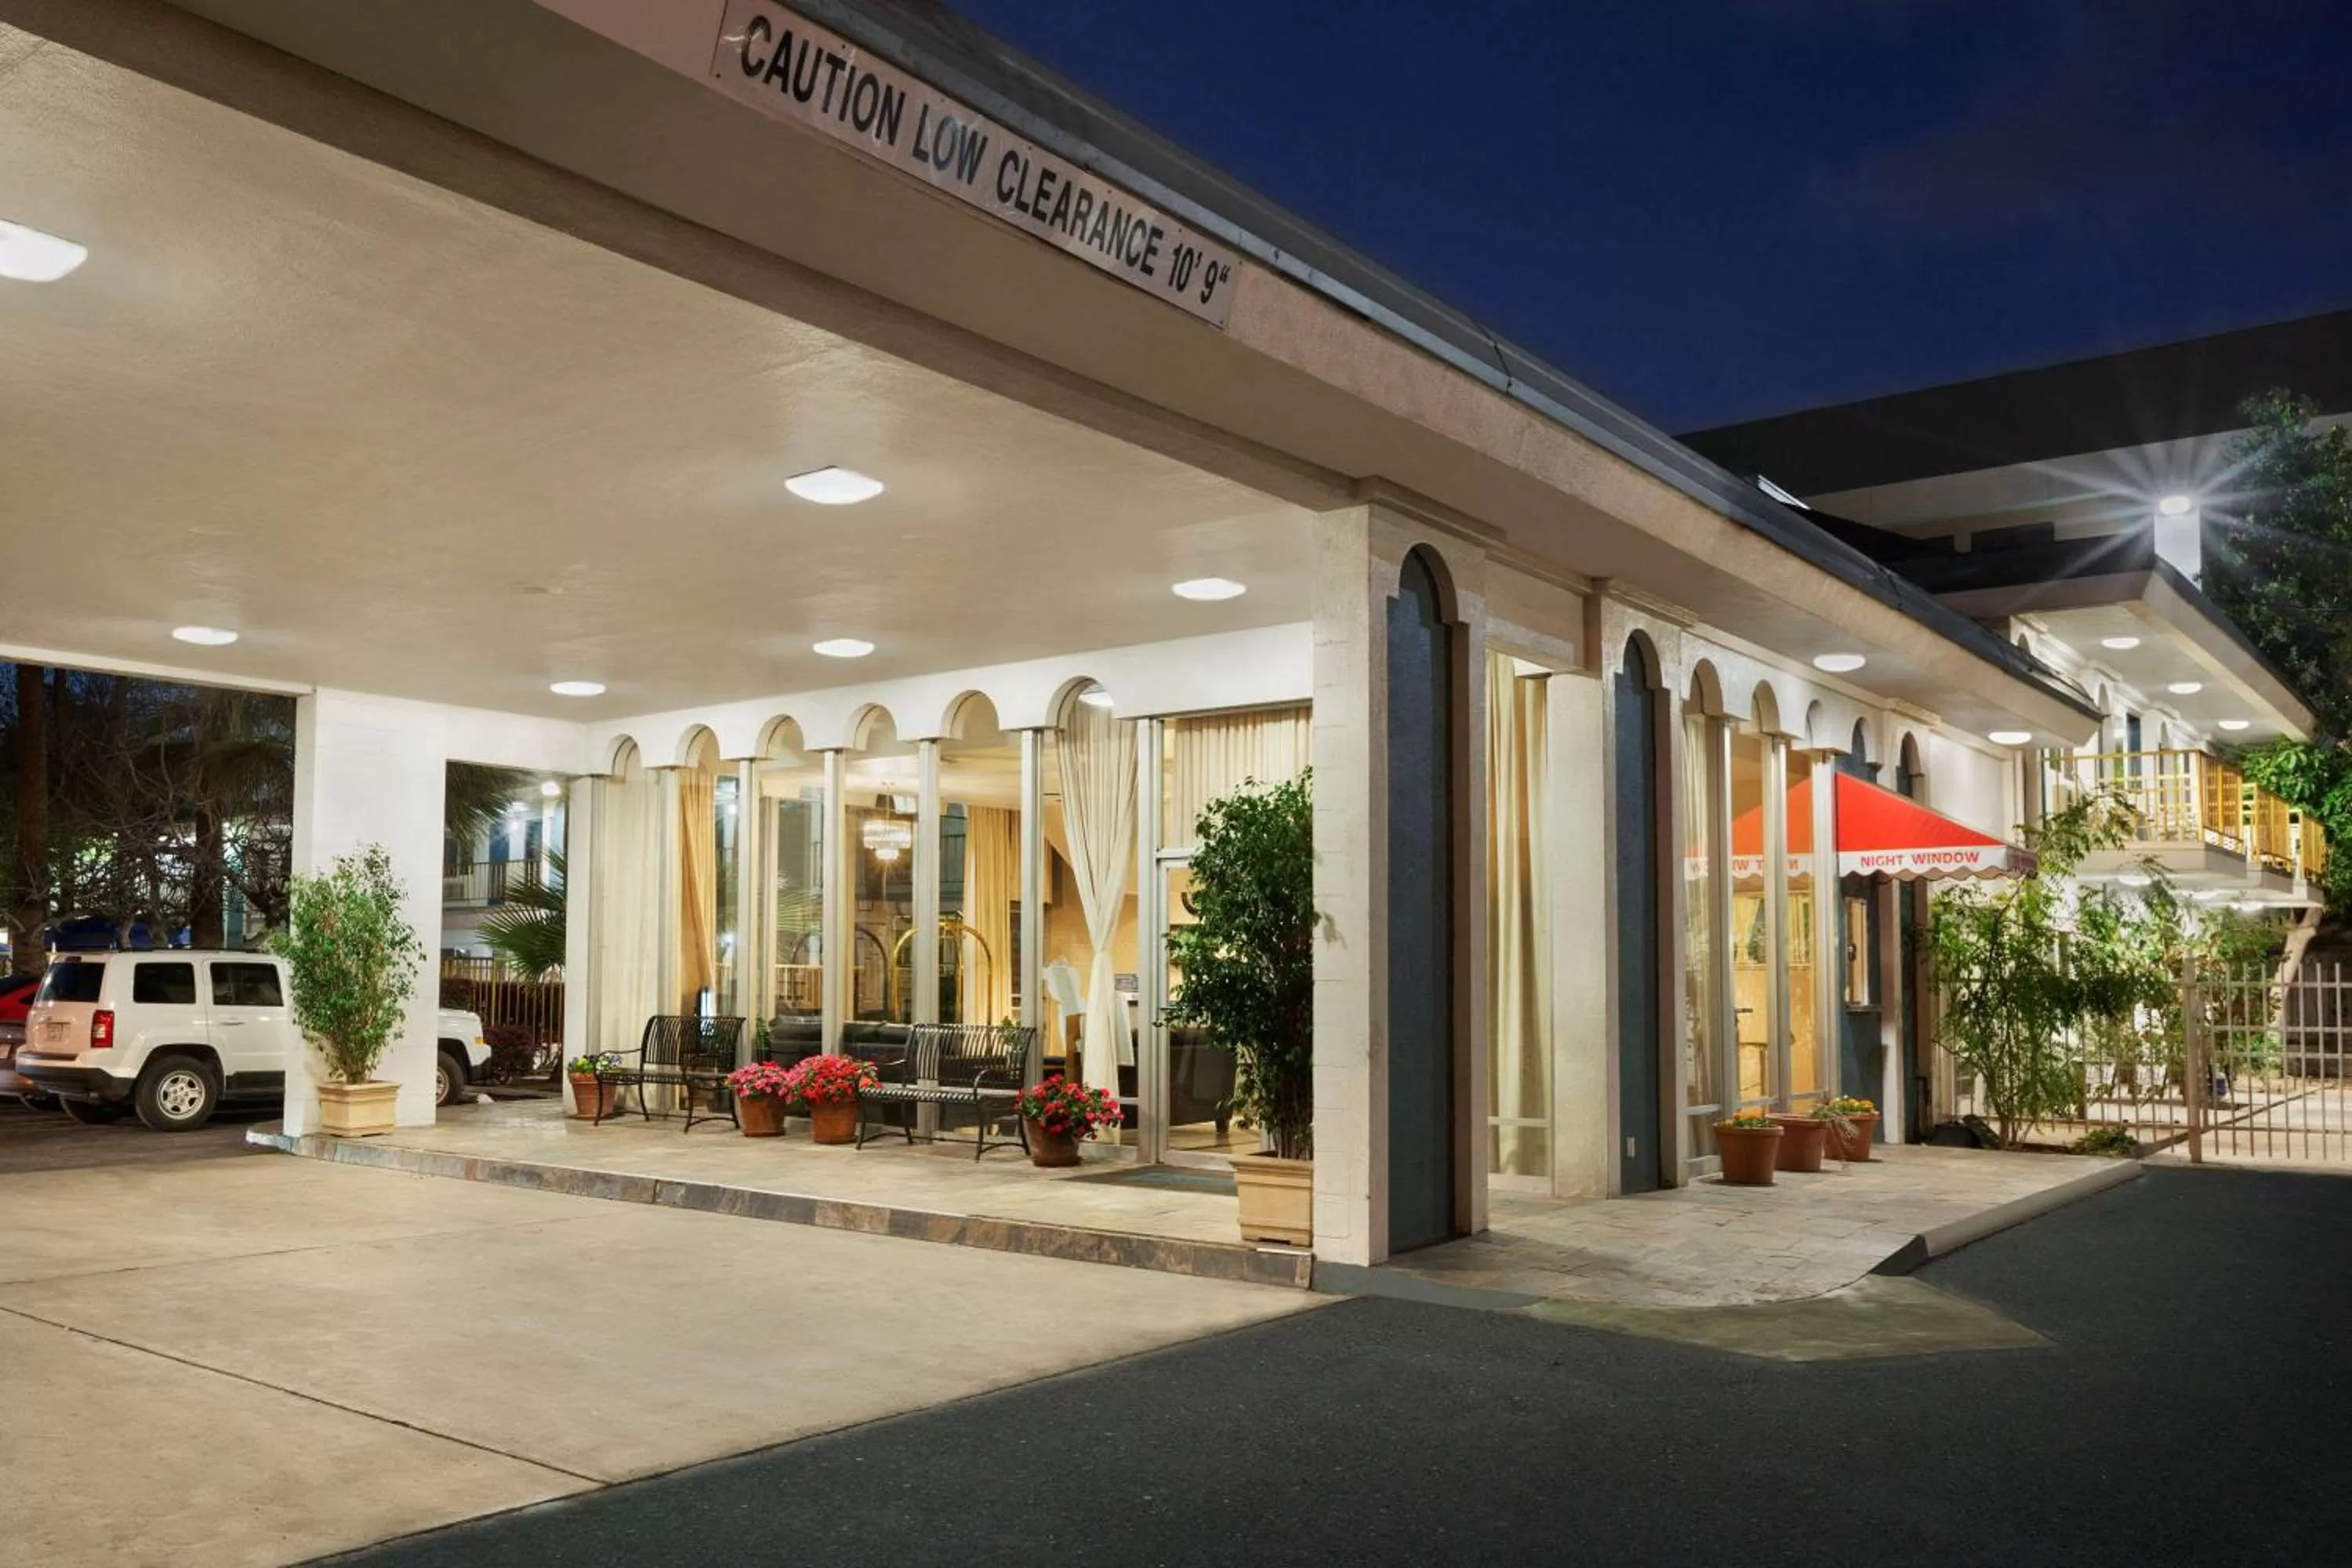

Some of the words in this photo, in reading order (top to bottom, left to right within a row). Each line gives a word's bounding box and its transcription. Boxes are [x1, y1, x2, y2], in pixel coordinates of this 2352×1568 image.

[741, 15, 906, 147] CAUTION
[912, 103, 988, 185] LOW
[996, 150, 1164, 276] CLEARANCE
[1860, 855, 1904, 866] NIGHT
[1911, 851, 1980, 865] WINDOW
